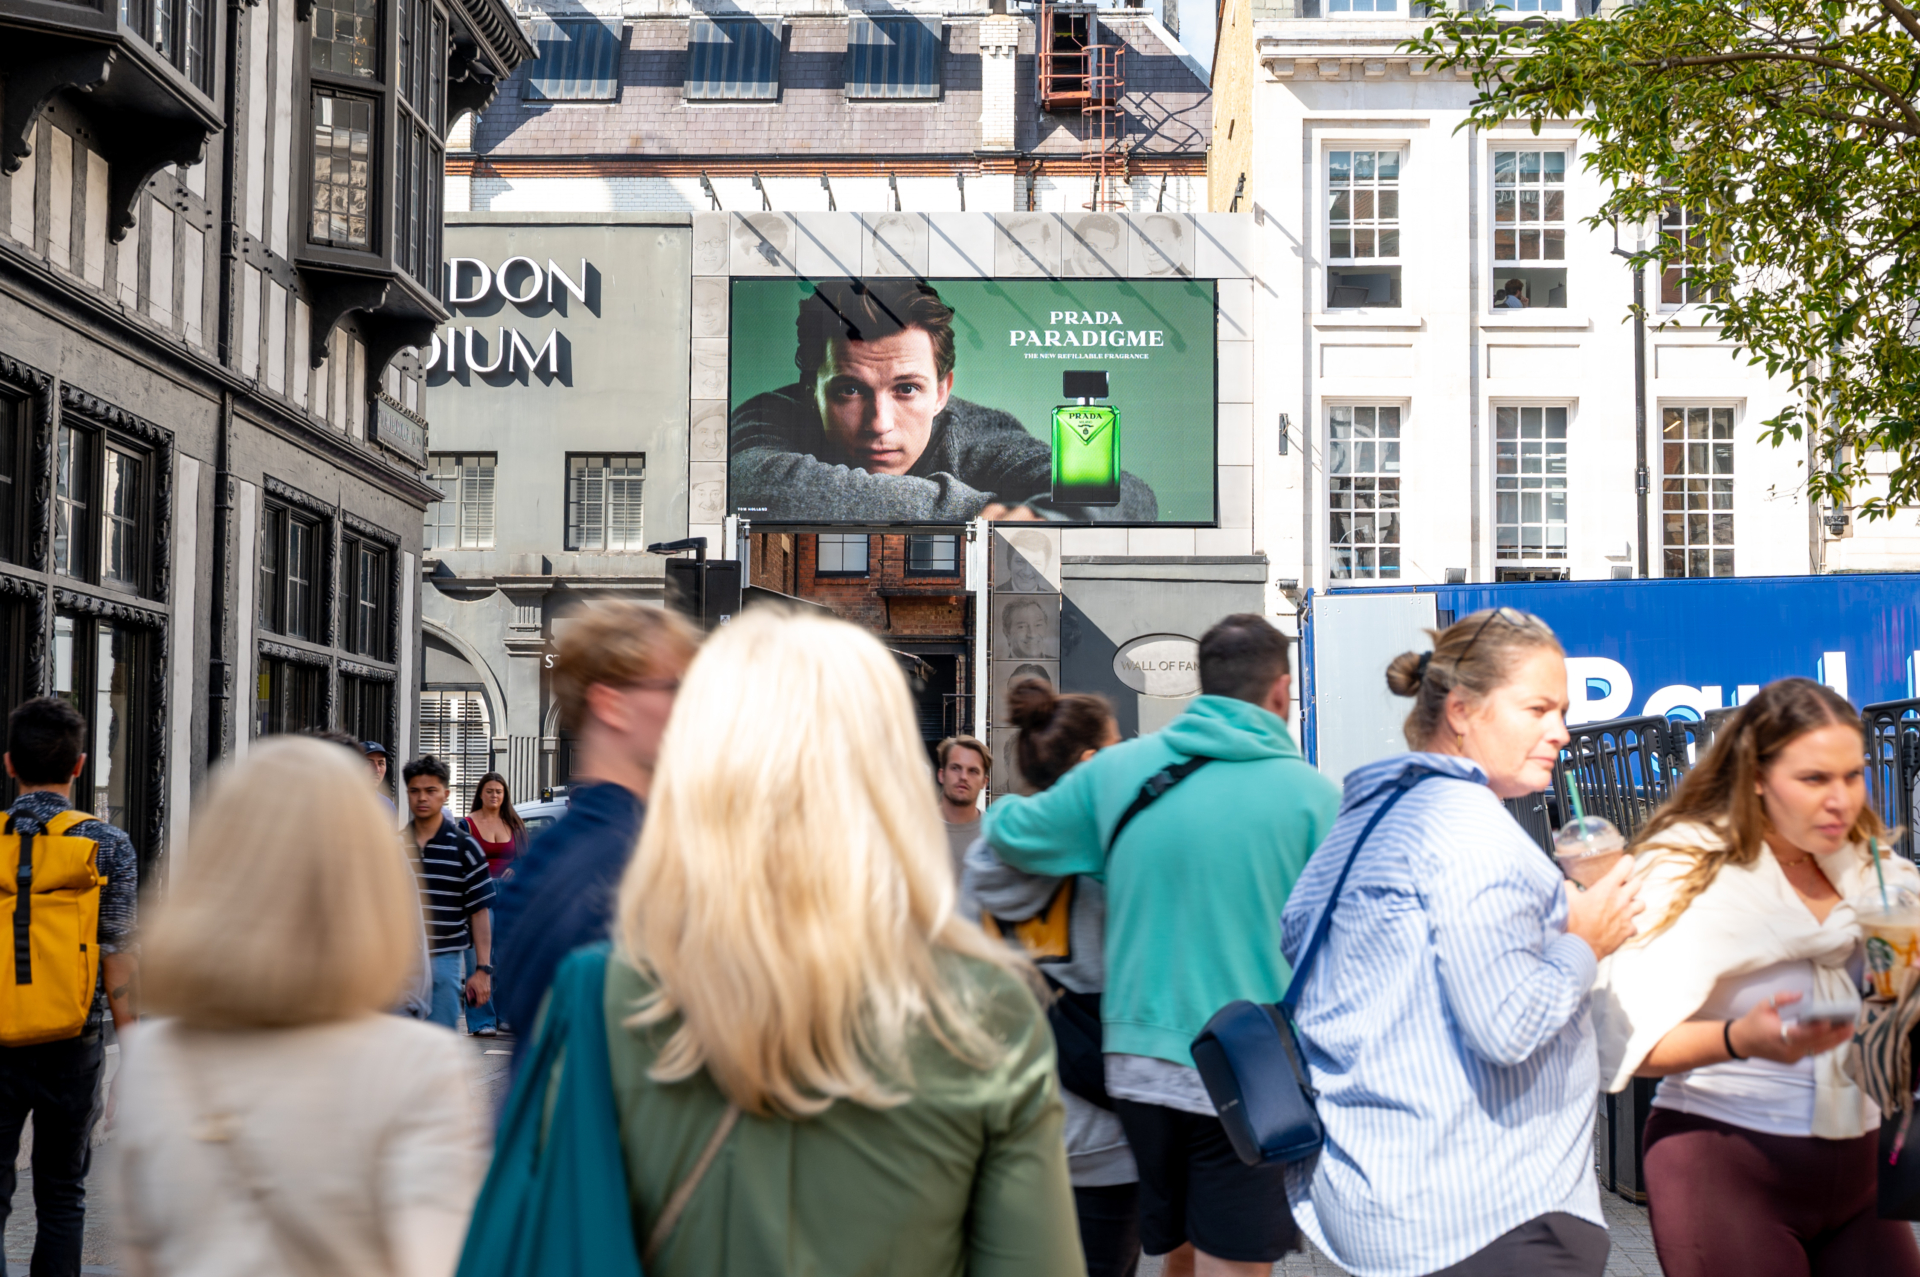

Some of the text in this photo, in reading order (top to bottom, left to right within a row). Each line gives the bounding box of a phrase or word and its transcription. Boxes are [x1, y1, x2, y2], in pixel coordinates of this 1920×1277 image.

[1050, 311, 1123, 325] PRADA
[1009, 330, 1164, 347] PARADIGME
[1120, 661, 1156, 671] WALL
[1158, 661, 1175, 671] OF
